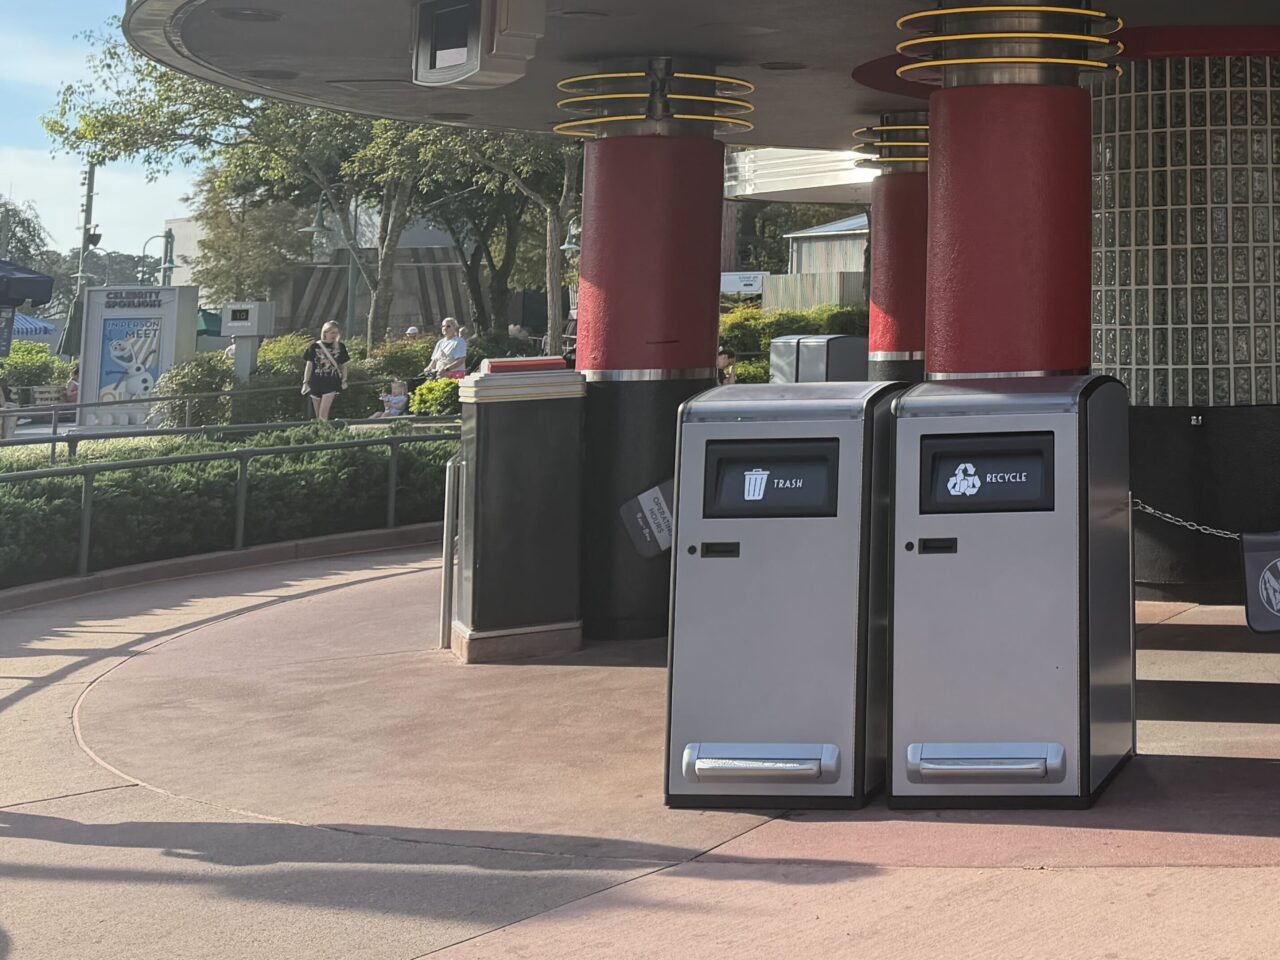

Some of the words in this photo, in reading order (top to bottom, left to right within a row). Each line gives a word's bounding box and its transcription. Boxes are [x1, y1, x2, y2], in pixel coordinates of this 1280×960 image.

[125, 328, 160, 339] MEET
[986, 472, 1028, 483] RECYCLE
[773, 478, 804, 489] TRASH
[649, 507, 665, 534] HOURS
